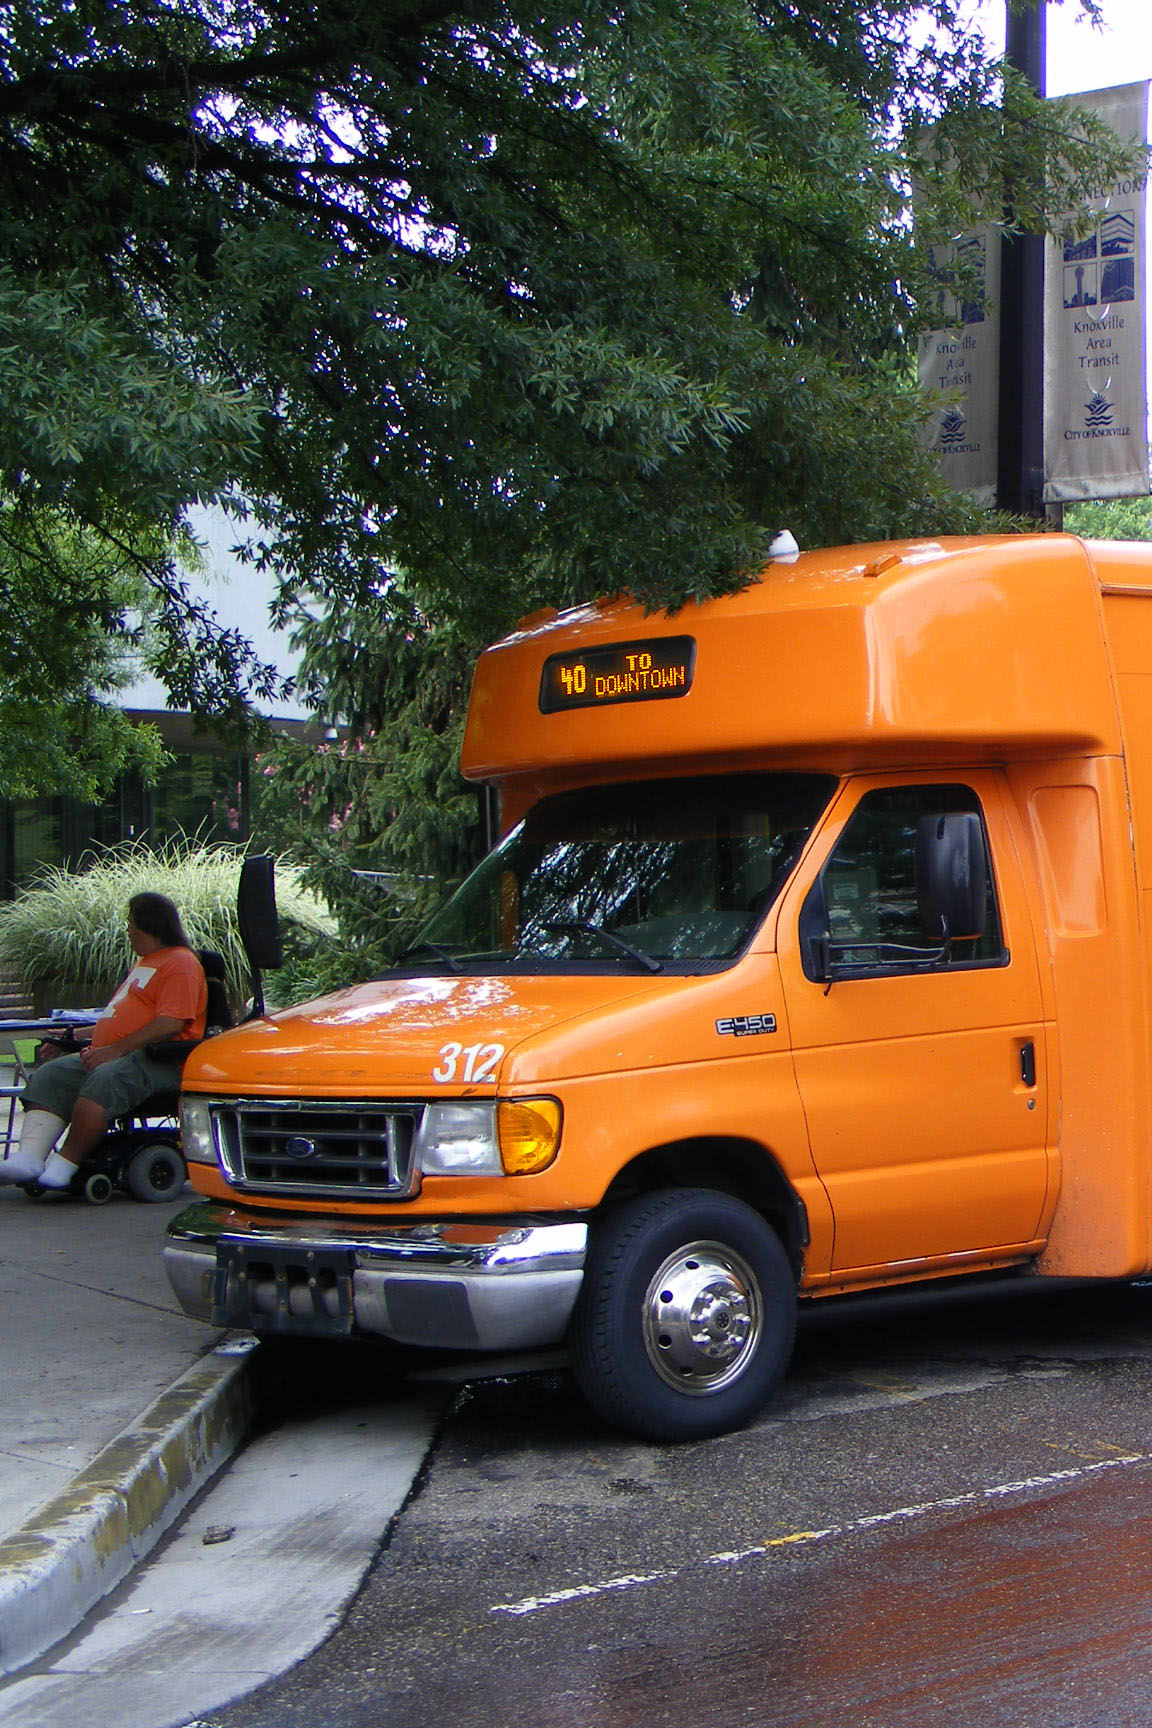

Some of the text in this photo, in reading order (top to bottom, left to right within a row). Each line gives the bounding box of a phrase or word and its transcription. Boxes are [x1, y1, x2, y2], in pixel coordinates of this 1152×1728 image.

[1073, 315, 1125, 333] Knoxville
[1086, 337, 1112, 350] Area
[1078, 353, 1120, 368] Transit
[1091, 427, 1129, 438] KNOXVILLE
[625, 653, 652, 672] TO
[560, 664, 586, 695] 40
[594, 665, 686, 697] DOWNTOWN
[432, 1042, 505, 1084] 312
